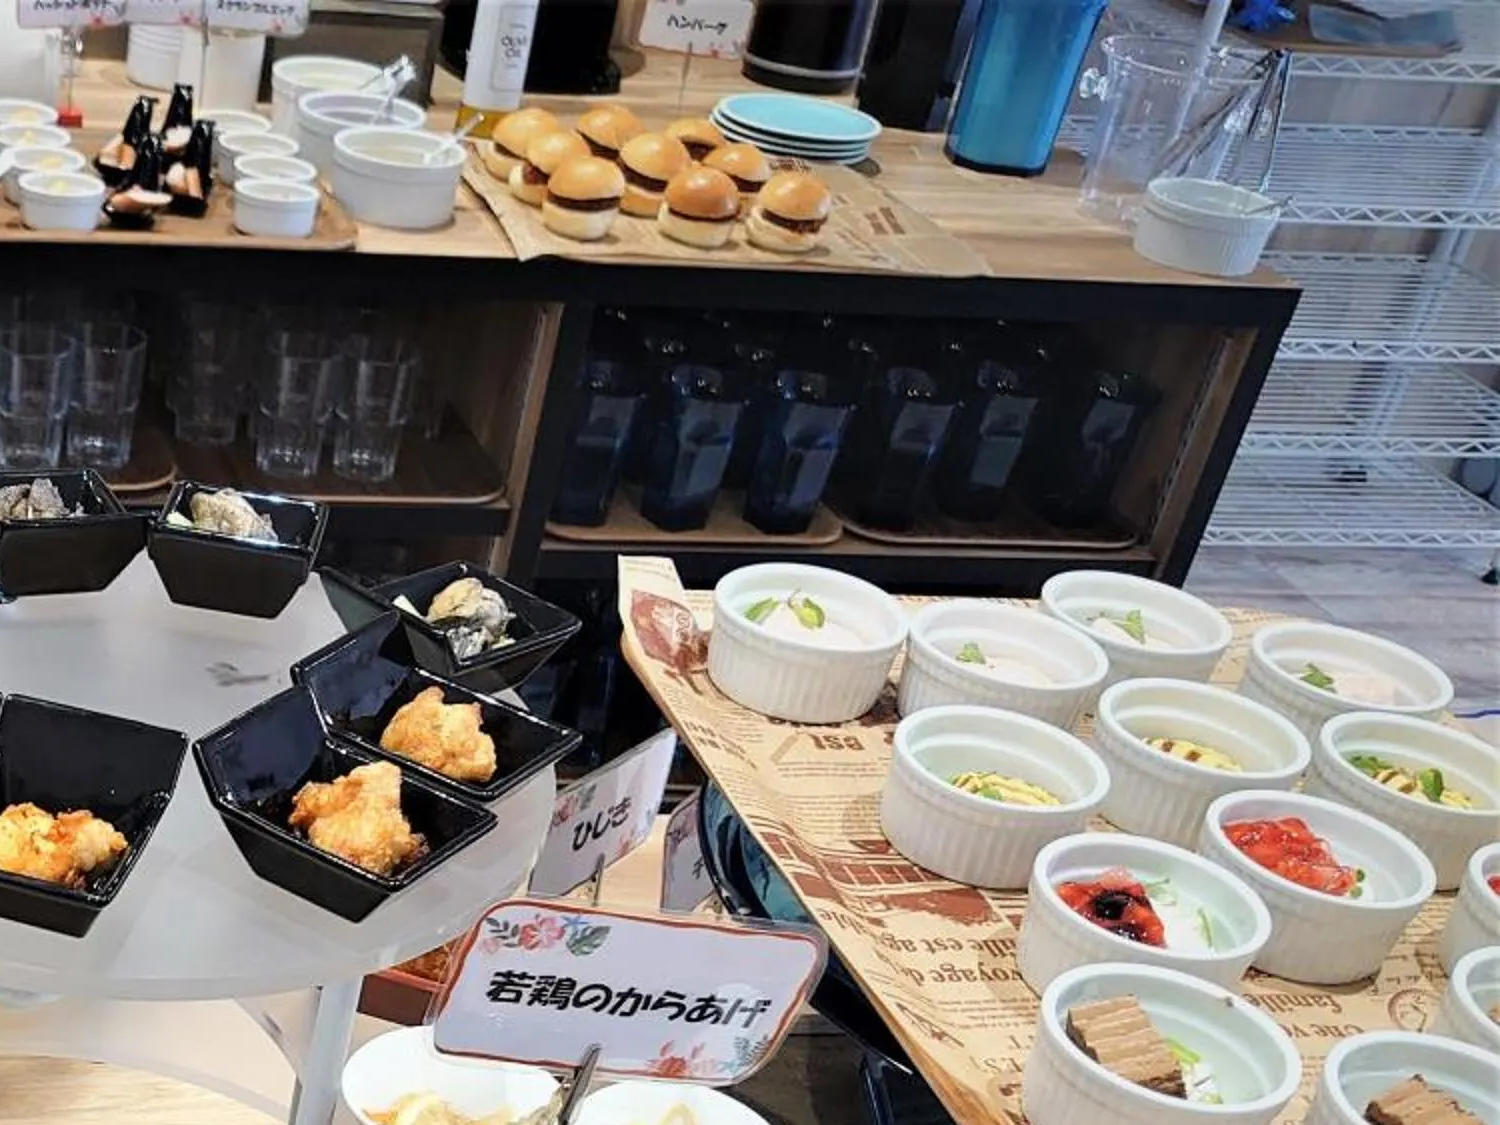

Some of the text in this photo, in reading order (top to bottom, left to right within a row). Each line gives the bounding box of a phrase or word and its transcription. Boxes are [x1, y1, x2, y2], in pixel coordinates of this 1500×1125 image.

[572, 797, 631, 851] ひじき
[486, 969, 771, 1028] 若鶏のからあげ
[1243, 992, 1344, 1014] famille
